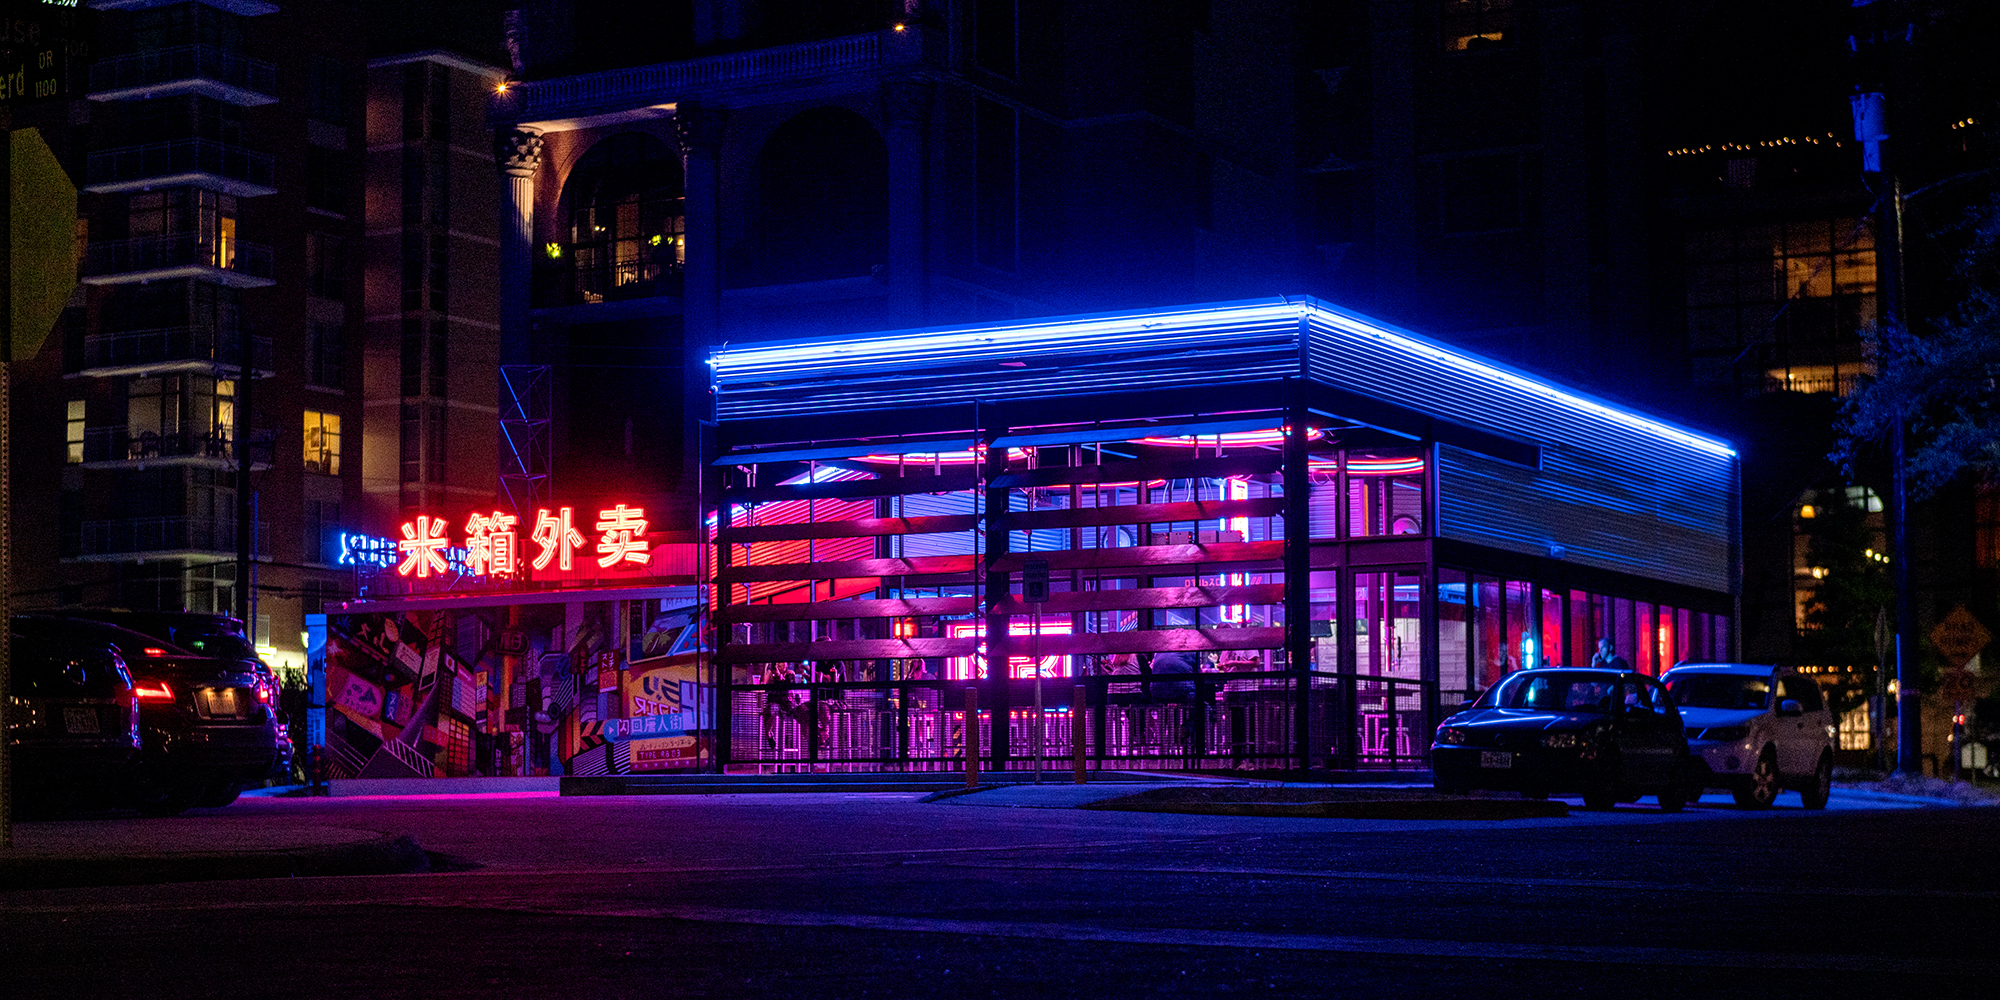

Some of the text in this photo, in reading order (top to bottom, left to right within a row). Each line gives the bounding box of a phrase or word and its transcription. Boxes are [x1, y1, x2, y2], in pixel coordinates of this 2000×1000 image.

[38, 49, 54, 70] DR
[35, 78, 57, 99] 1100
[397, 503, 651, 579] 米箱外卖
